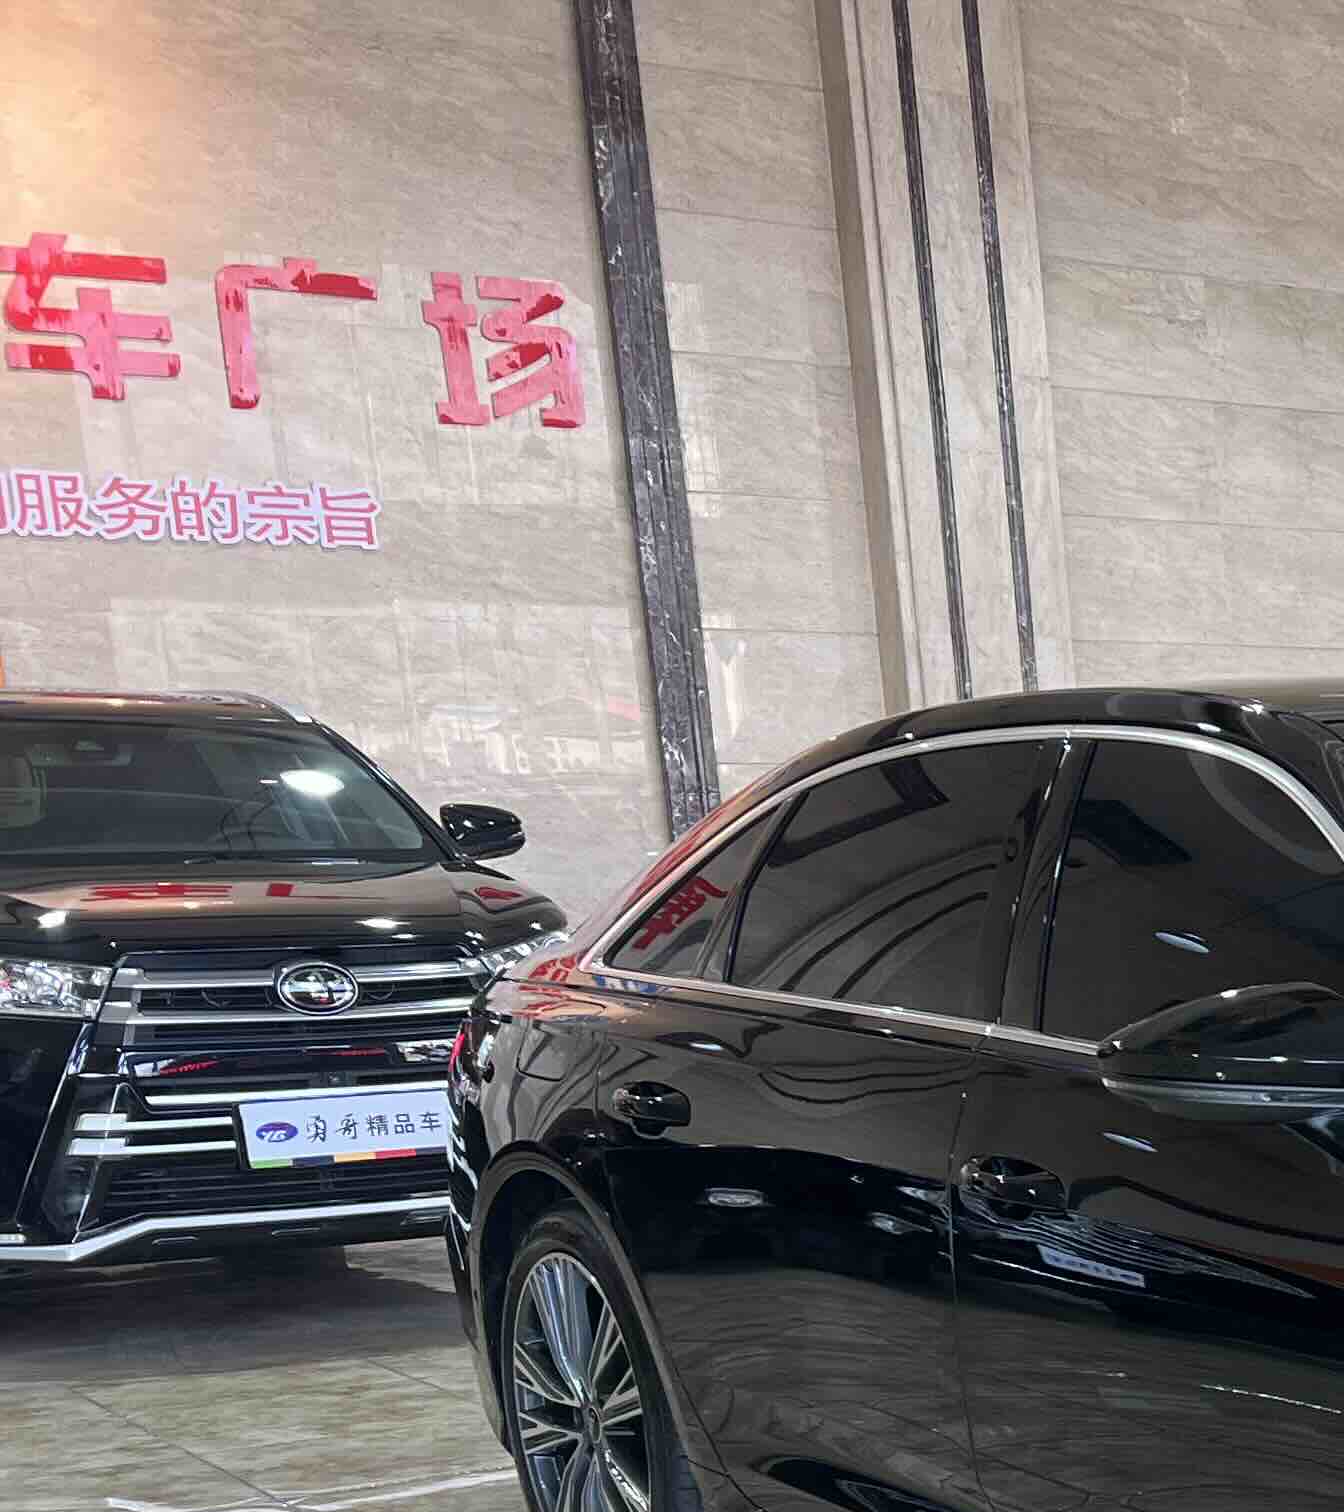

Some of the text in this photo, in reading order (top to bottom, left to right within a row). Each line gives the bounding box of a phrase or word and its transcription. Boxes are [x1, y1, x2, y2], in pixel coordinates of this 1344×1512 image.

[0, 232, 586, 429] 车广场
[305, 1111, 442, 1143] 勇哥精品车
